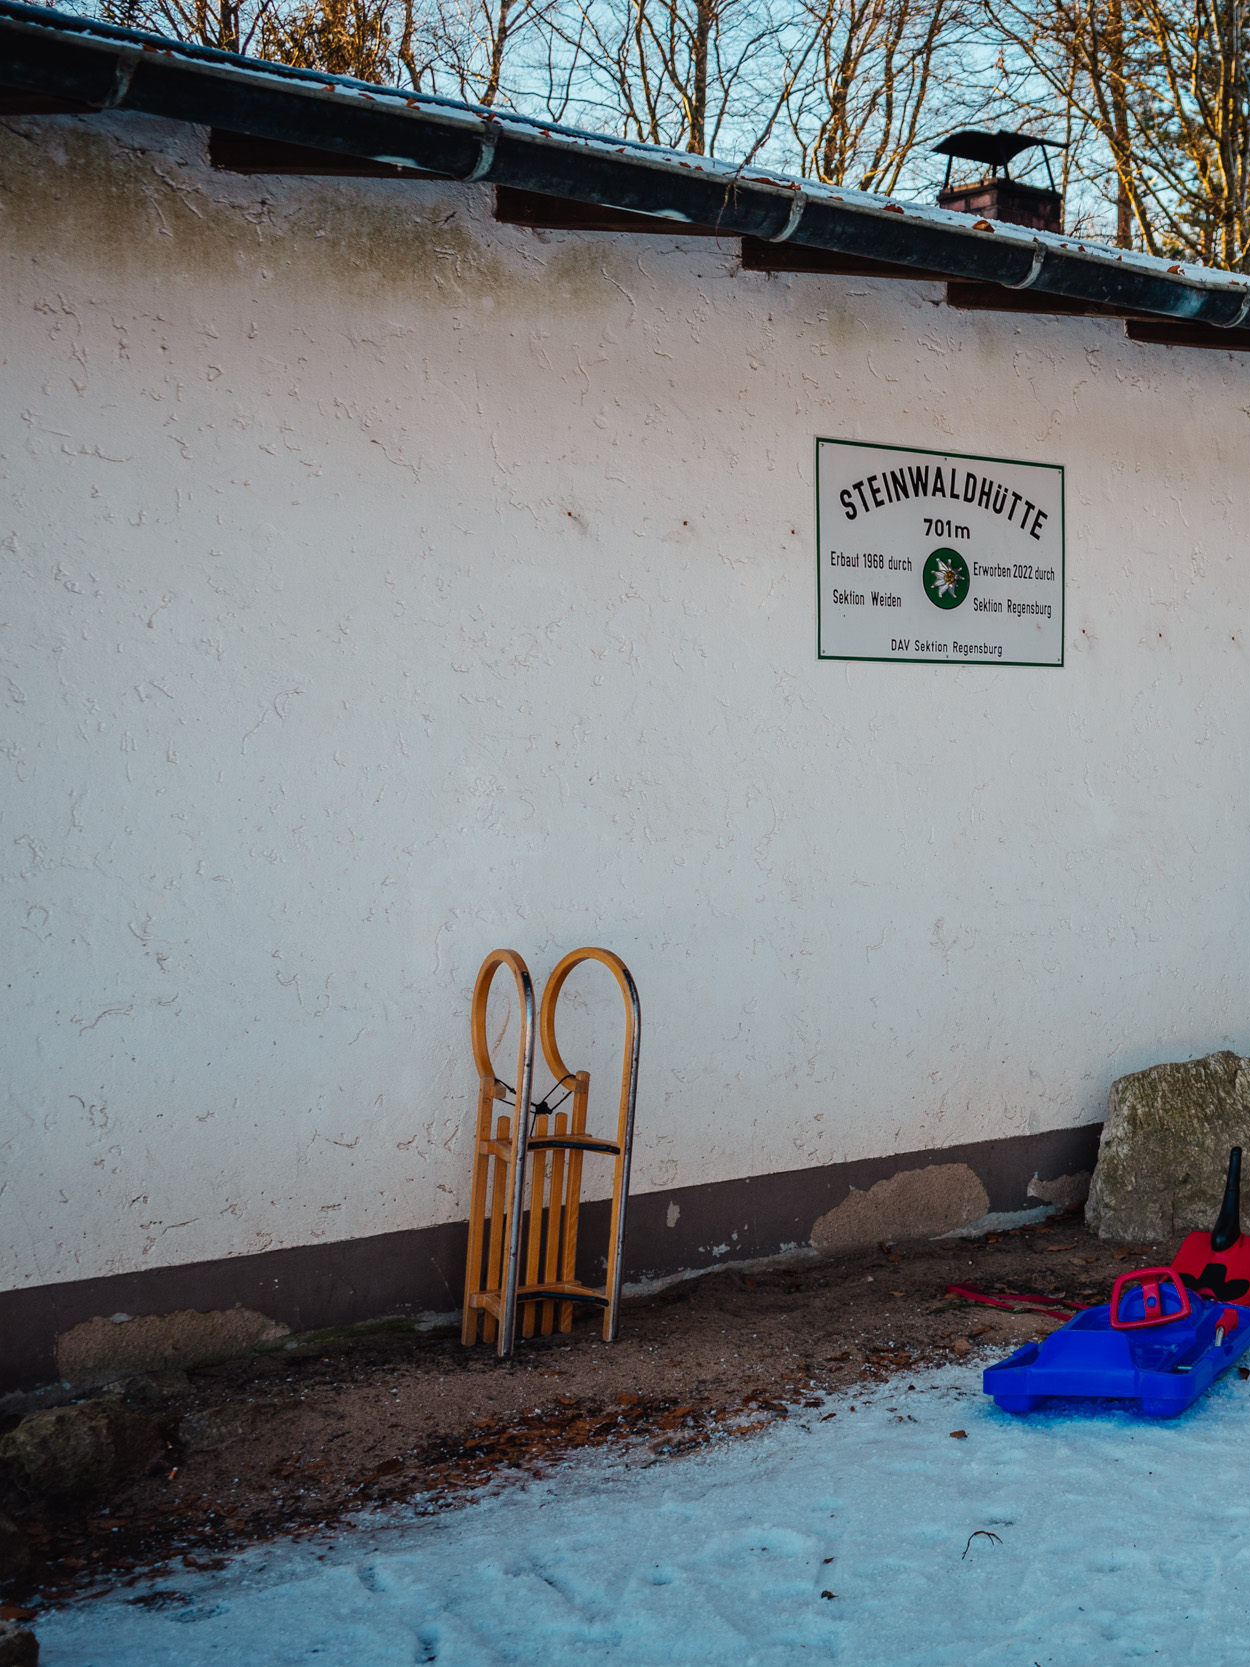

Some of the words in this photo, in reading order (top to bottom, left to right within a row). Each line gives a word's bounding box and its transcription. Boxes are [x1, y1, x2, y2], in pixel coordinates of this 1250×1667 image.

[840, 465, 1048, 540] STEINWALDHÜTTE
[923, 518, 971, 540] 701m
[830, 551, 860, 568] Erbaut
[862, 553, 885, 569] 1968
[888, 555, 912, 572] durch
[973, 561, 1012, 578] Erworben
[1013, 564, 1033, 580] 2022
[1035, 566, 1055, 581] durch
[832, 589, 865, 606] Sektion
[871, 591, 902, 608] Weiden
[973, 597, 1003, 613] Sektion
[1007, 599, 1052, 619] Regensburg
[891, 639, 910, 652] DAV
[914, 640, 948, 653] Sektion
[952, 641, 1003, 657] Regensburg
